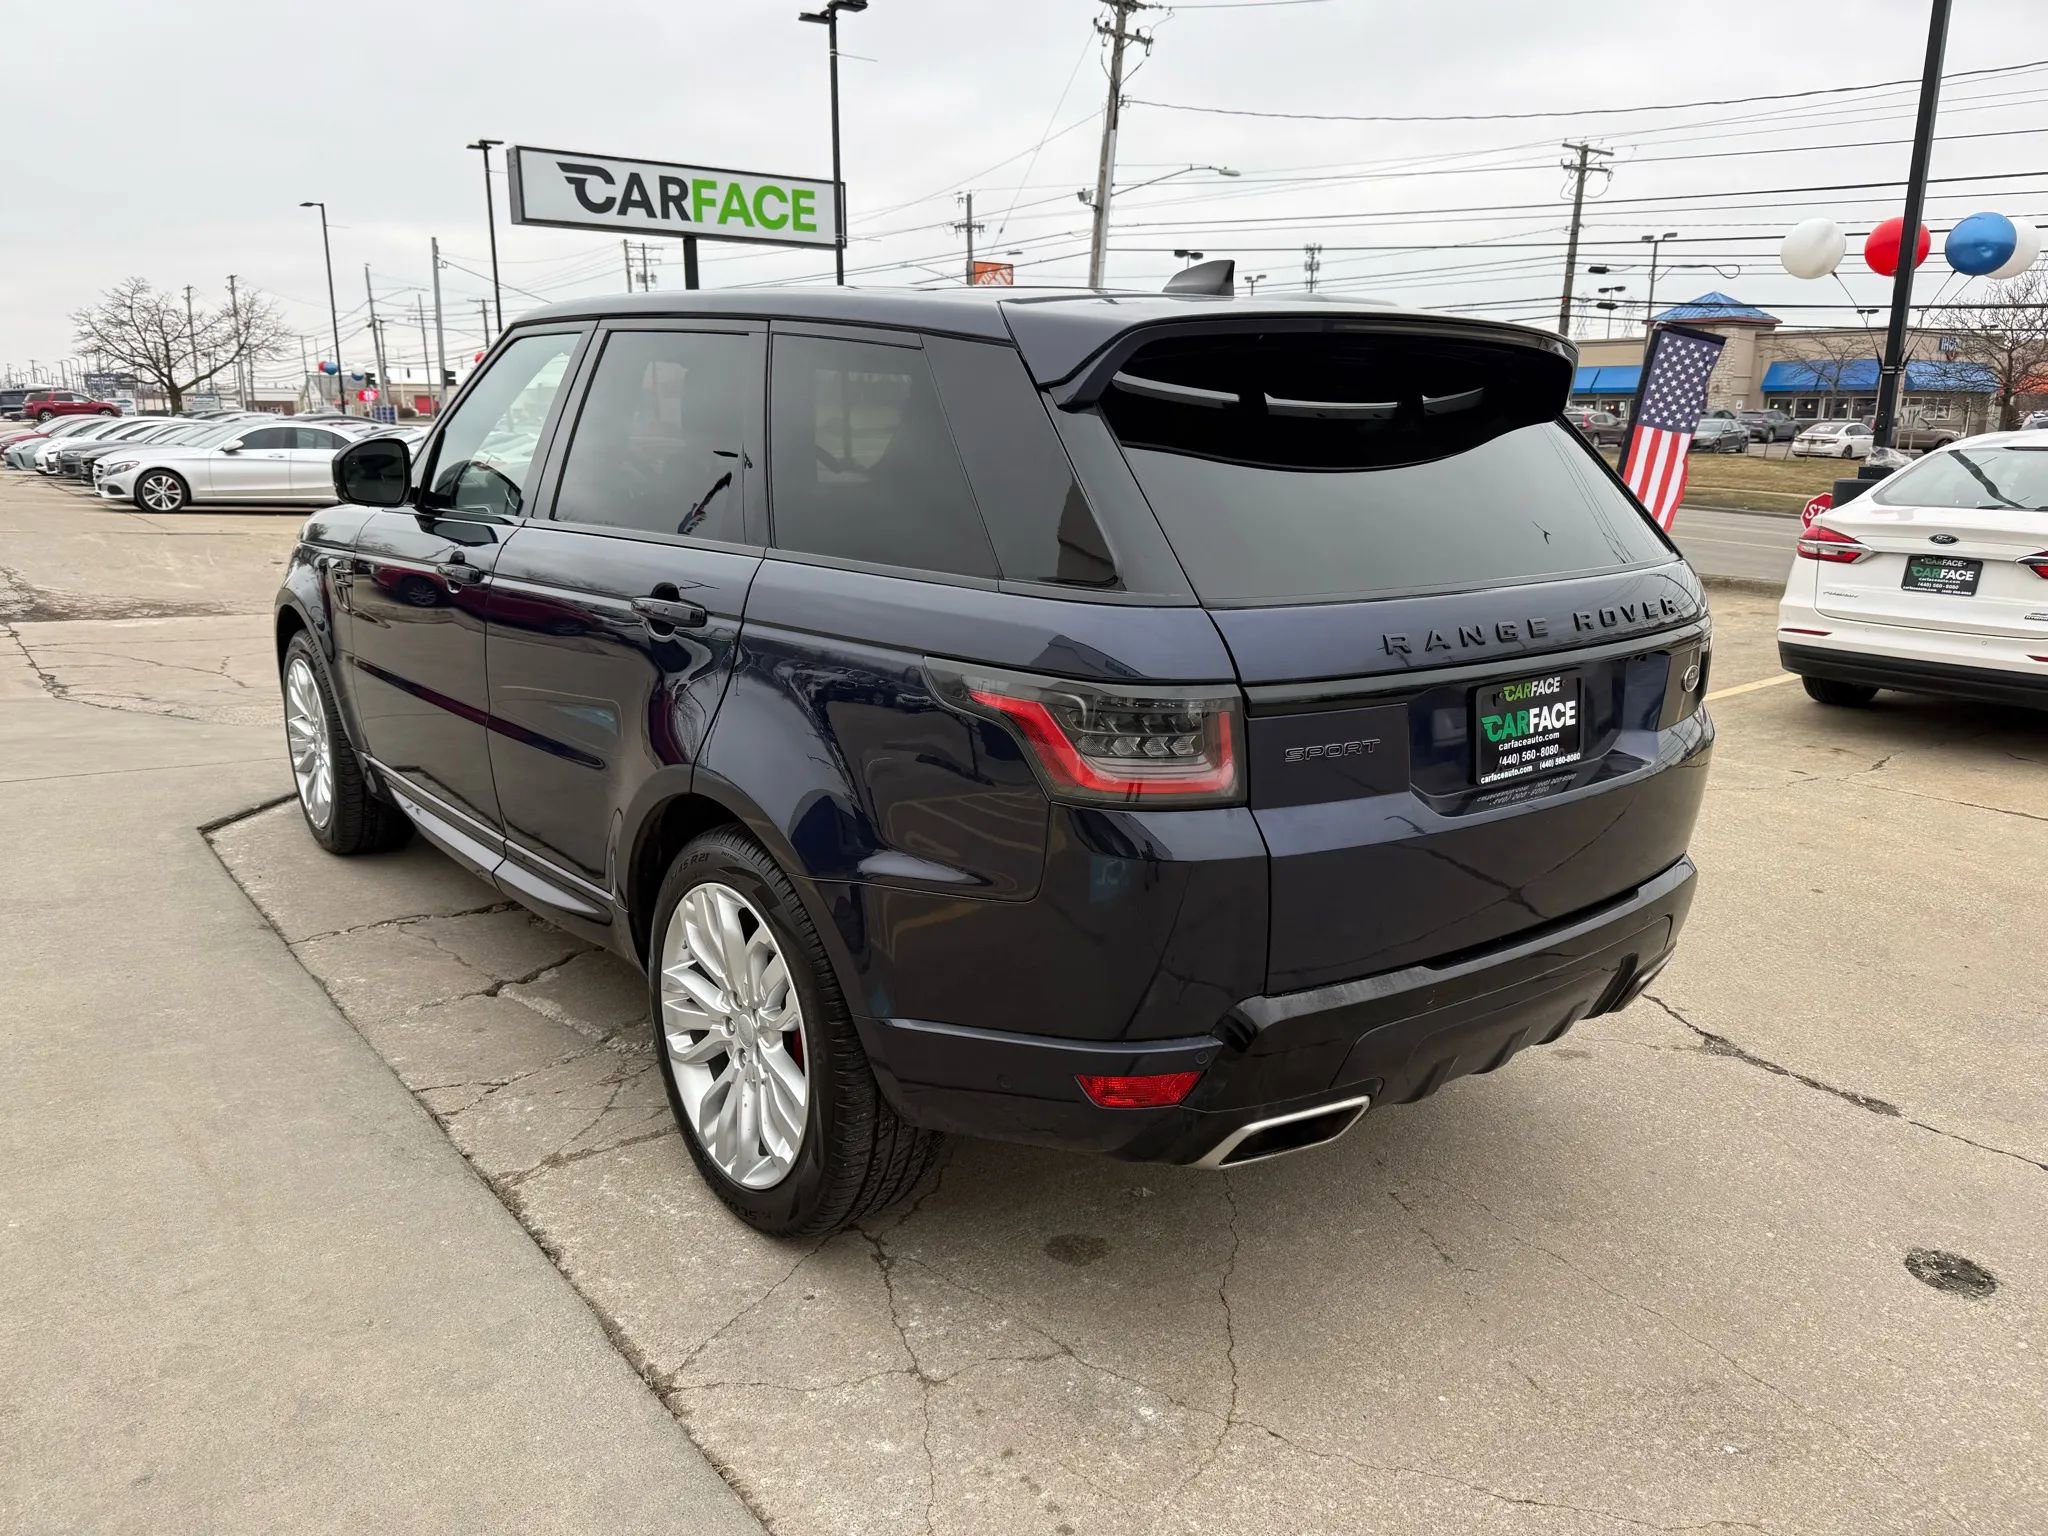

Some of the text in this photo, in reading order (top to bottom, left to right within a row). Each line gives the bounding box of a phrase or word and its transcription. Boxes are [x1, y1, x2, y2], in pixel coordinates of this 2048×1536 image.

[556, 161, 817, 233] CARFACE
[1924, 557, 1964, 567] CARFACE
[1911, 566, 1975, 581] CARFACE
[1382, 598, 1677, 655] RANGE ROVER
[1503, 676, 1561, 702] CARFACE
[1480, 700, 1576, 742] CARFACE
[1284, 738, 1381, 762] SPORT
[1498, 731, 1560, 751] carfaceauto.com
[1500, 753, 1520, 766] (440)
[1480, 765, 1533, 784] carfaceauto.com
